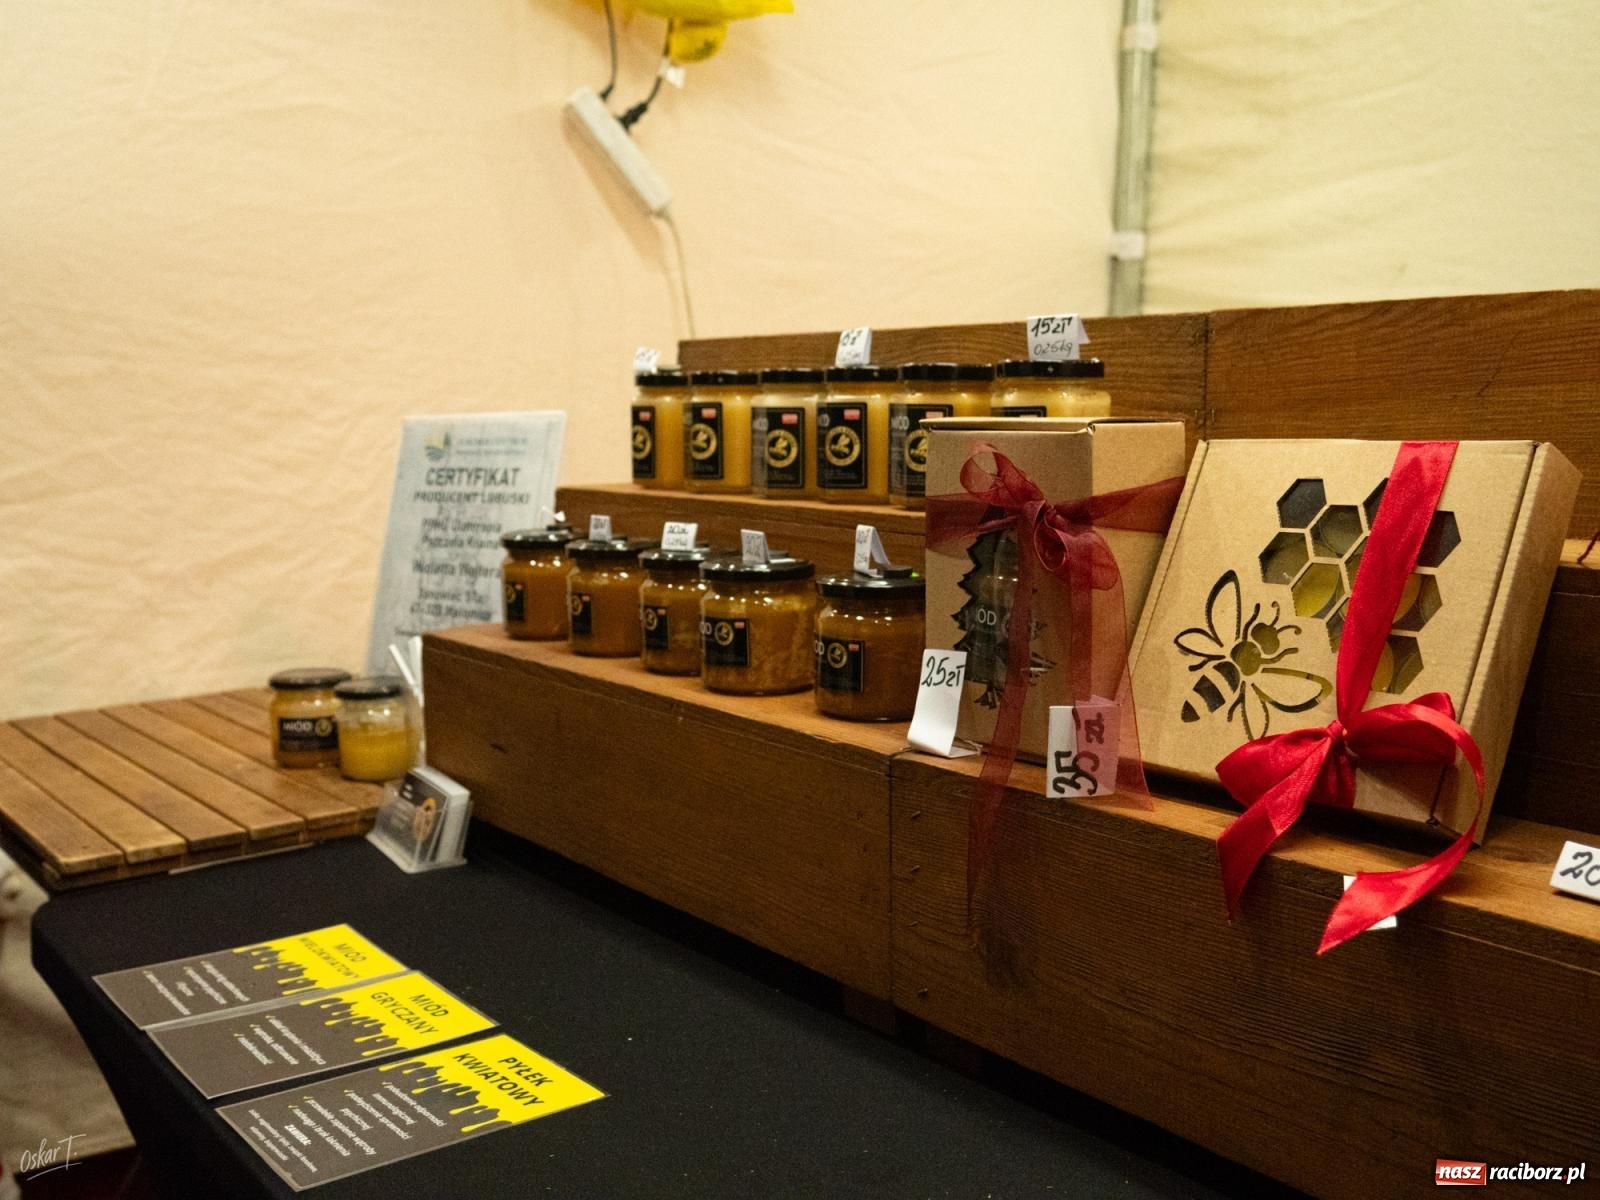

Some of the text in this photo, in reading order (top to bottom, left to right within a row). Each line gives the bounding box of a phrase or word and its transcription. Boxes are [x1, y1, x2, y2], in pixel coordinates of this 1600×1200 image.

[425, 467, 520, 487] CERTYFIKAT
[371, 992, 438, 1034] GRYCZANY
[409, 994, 449, 1016] MIÓD
[454, 1053, 544, 1105] KWIATOWY
[498, 1057, 552, 1086] PYŁEK
